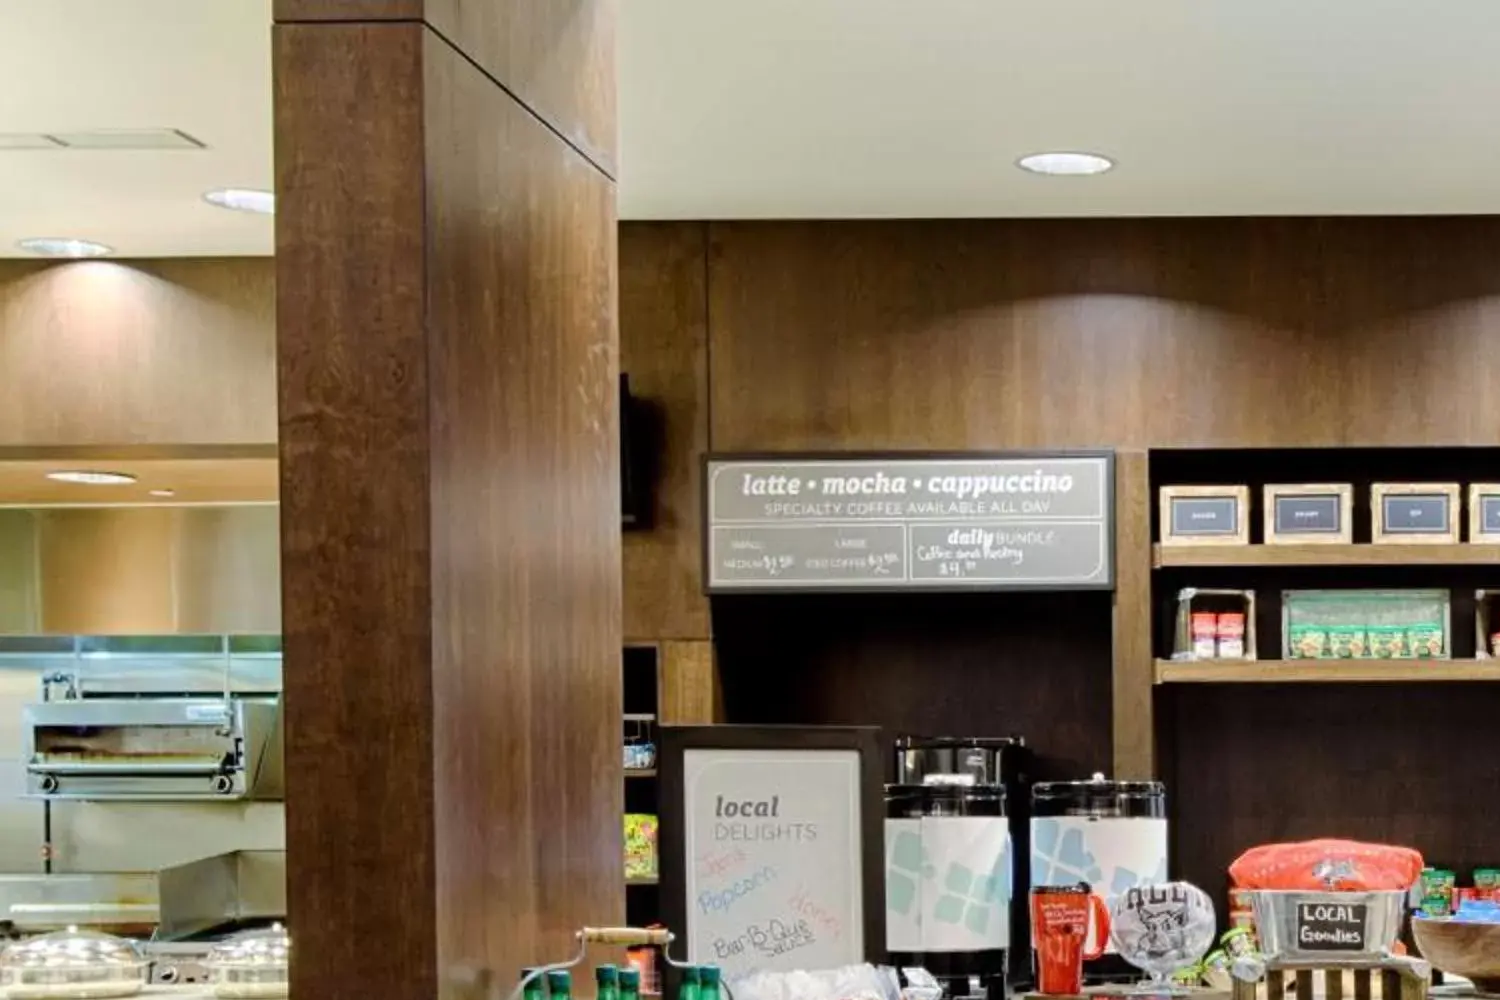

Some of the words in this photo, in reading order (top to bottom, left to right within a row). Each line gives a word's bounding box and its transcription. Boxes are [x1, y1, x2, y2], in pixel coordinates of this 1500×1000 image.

[743, 474, 801, 496] latte
[822, 474, 907, 496] mocha
[928, 473, 1074, 499] cappuccino
[764, 501, 842, 516] SPECIALTY
[847, 501, 903, 515] COFFEE
[909, 500, 987, 514] AVAILABLE
[990, 500, 1018, 513] ALL
[1022, 499, 1051, 513] DAY
[948, 528, 994, 549] daily
[715, 795, 779, 817] local
[714, 823, 817, 841] DELIGHTS
[698, 866, 776, 915] Popcorn
[1303, 906, 1360, 924] LOCAL
